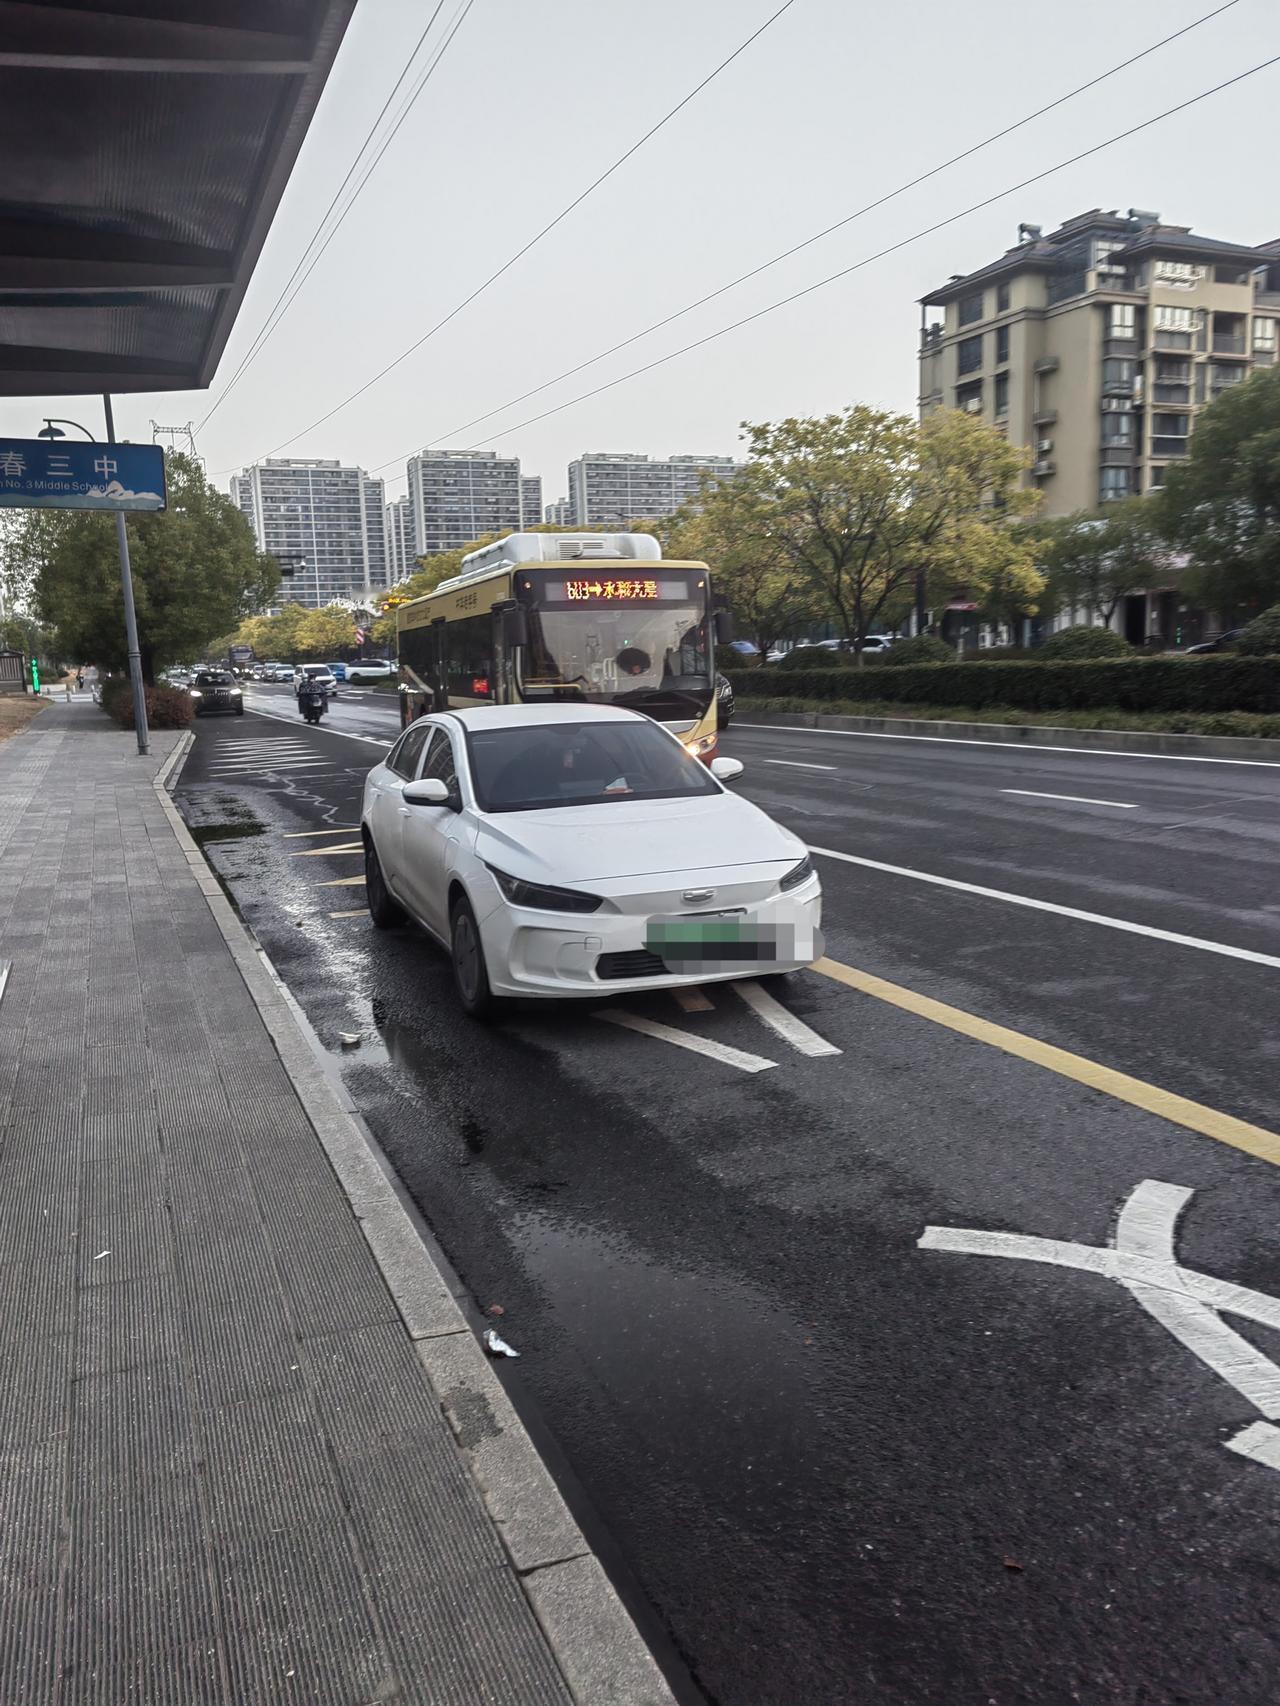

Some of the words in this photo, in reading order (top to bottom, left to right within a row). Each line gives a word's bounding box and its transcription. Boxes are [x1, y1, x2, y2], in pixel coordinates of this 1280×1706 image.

[0, 451, 118, 480] 春三中
[34, 480, 70, 490] Middle
